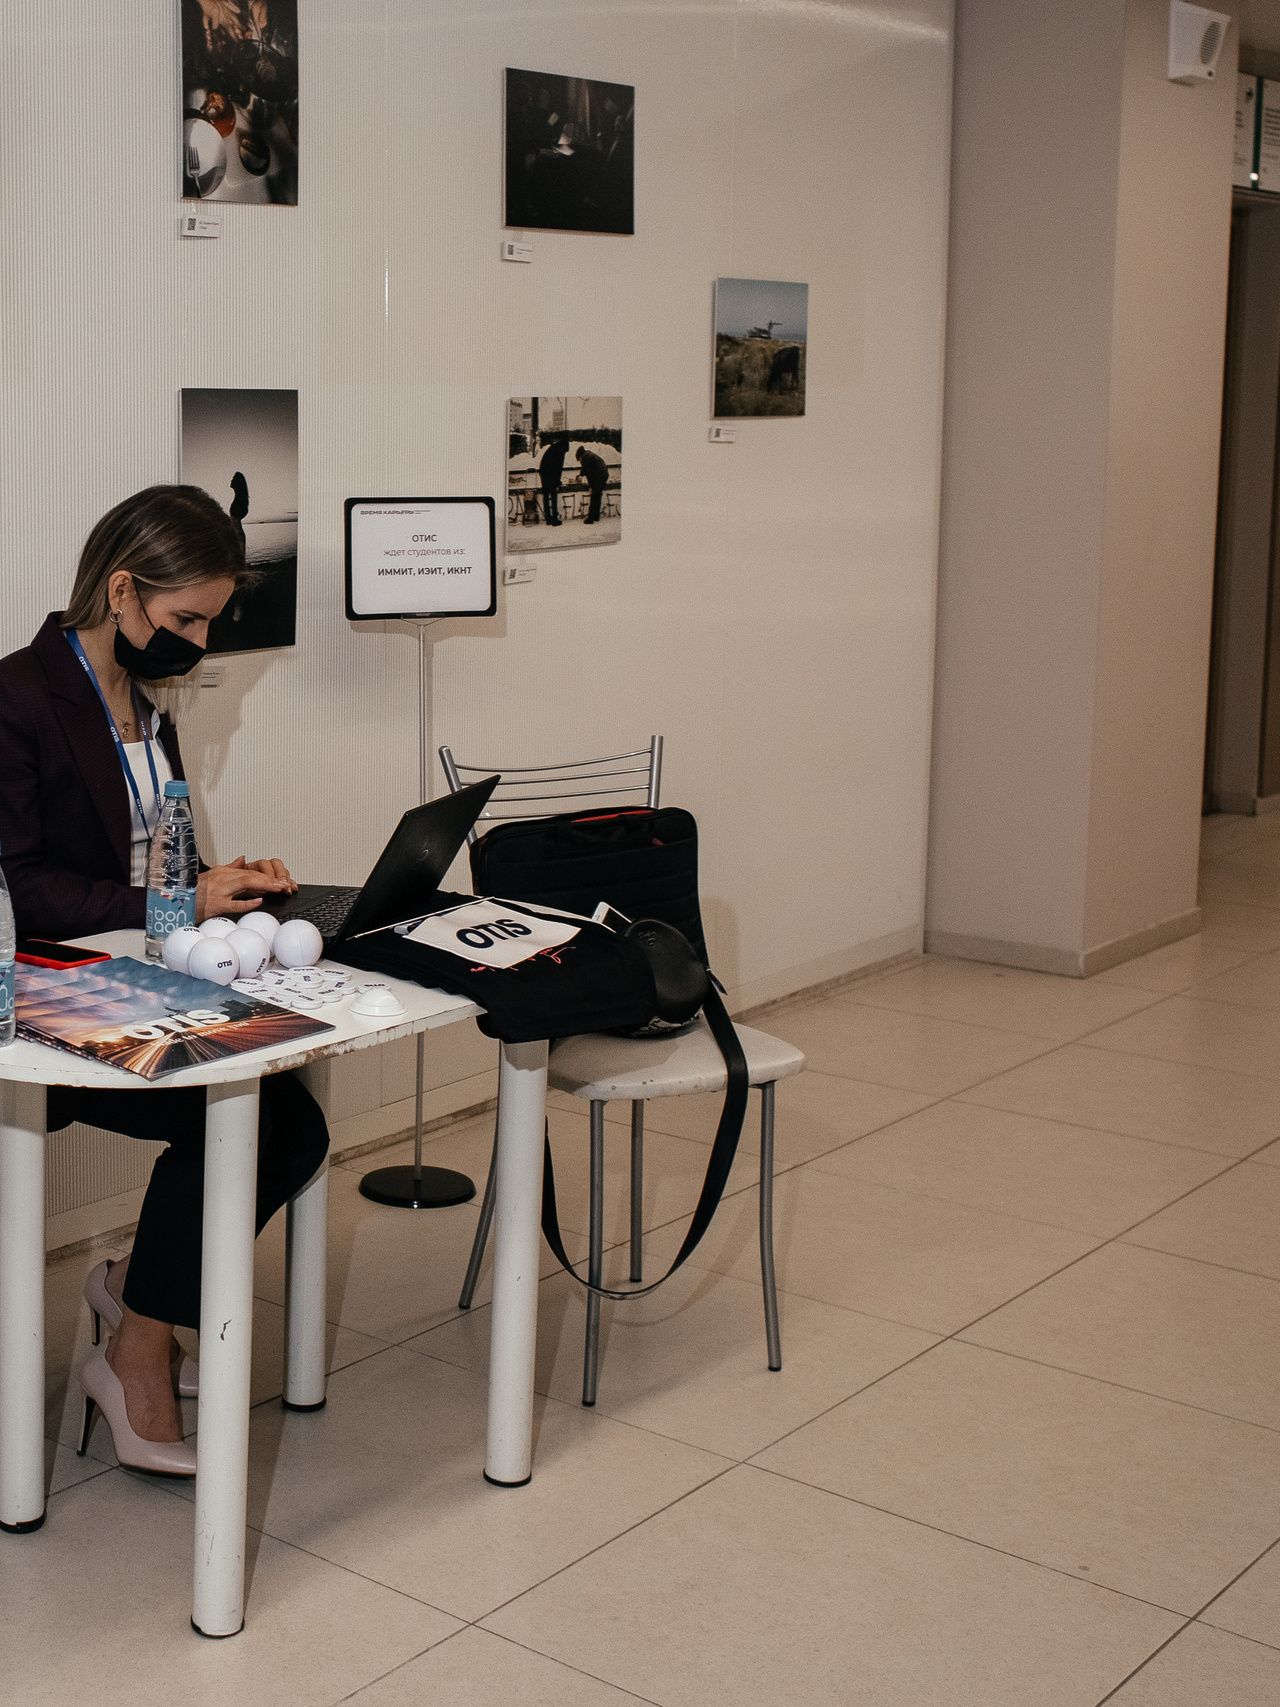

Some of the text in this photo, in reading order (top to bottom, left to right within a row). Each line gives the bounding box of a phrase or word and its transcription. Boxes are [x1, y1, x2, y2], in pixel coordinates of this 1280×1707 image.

[412, 534, 437, 542] ОТИС
[407, 549, 451, 557] студентов
[378, 566, 472, 577] ИММИТ, ИЭИТ, ИКНТ
[79, 656, 90, 672] OTIS
[110, 726, 120, 743] OTIS
[154, 906, 187, 922] bon
[456, 918, 532, 949] OTIS
[217, 960, 233, 969] OTIS
[256, 958, 267, 973] OTIS
[121, 1009, 230, 1040] OTIS
